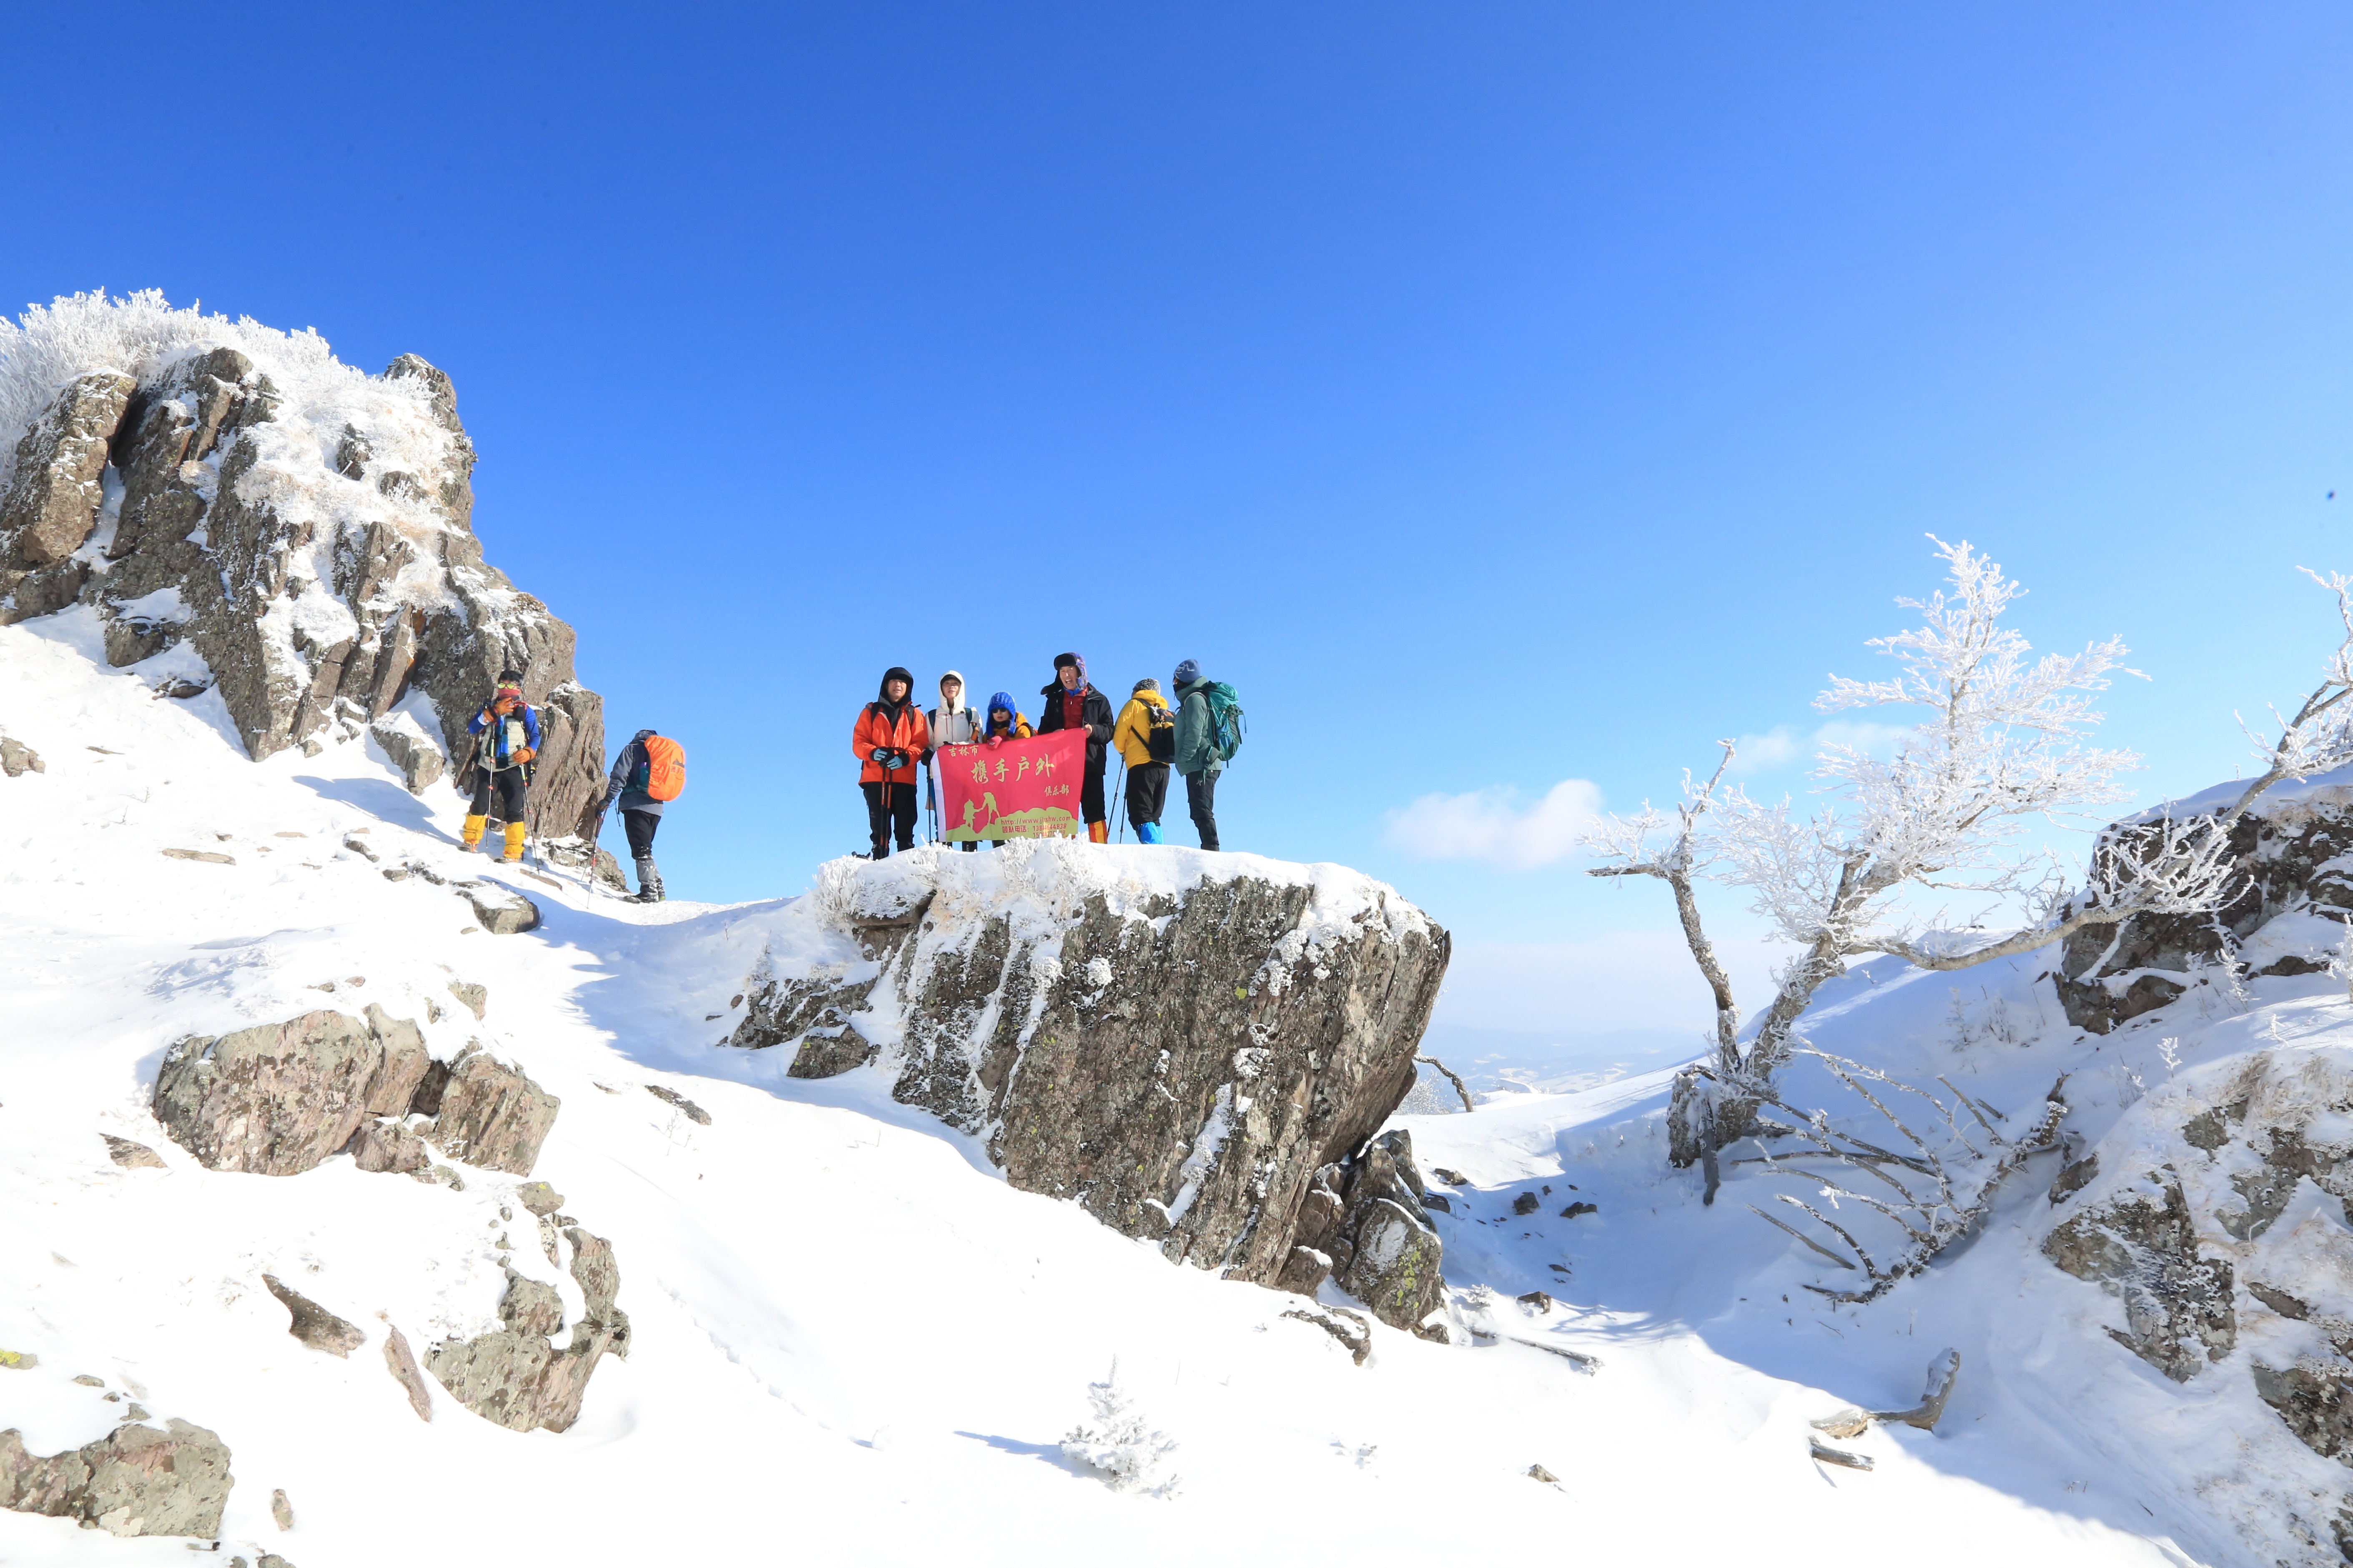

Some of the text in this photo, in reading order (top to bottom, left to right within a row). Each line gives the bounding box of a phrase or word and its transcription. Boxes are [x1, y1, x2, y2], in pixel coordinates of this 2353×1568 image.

[948, 745, 979, 757] 吉林市
[971, 753, 1055, 784] 携手户外
[1044, 784, 1069, 797] 俱乐部
